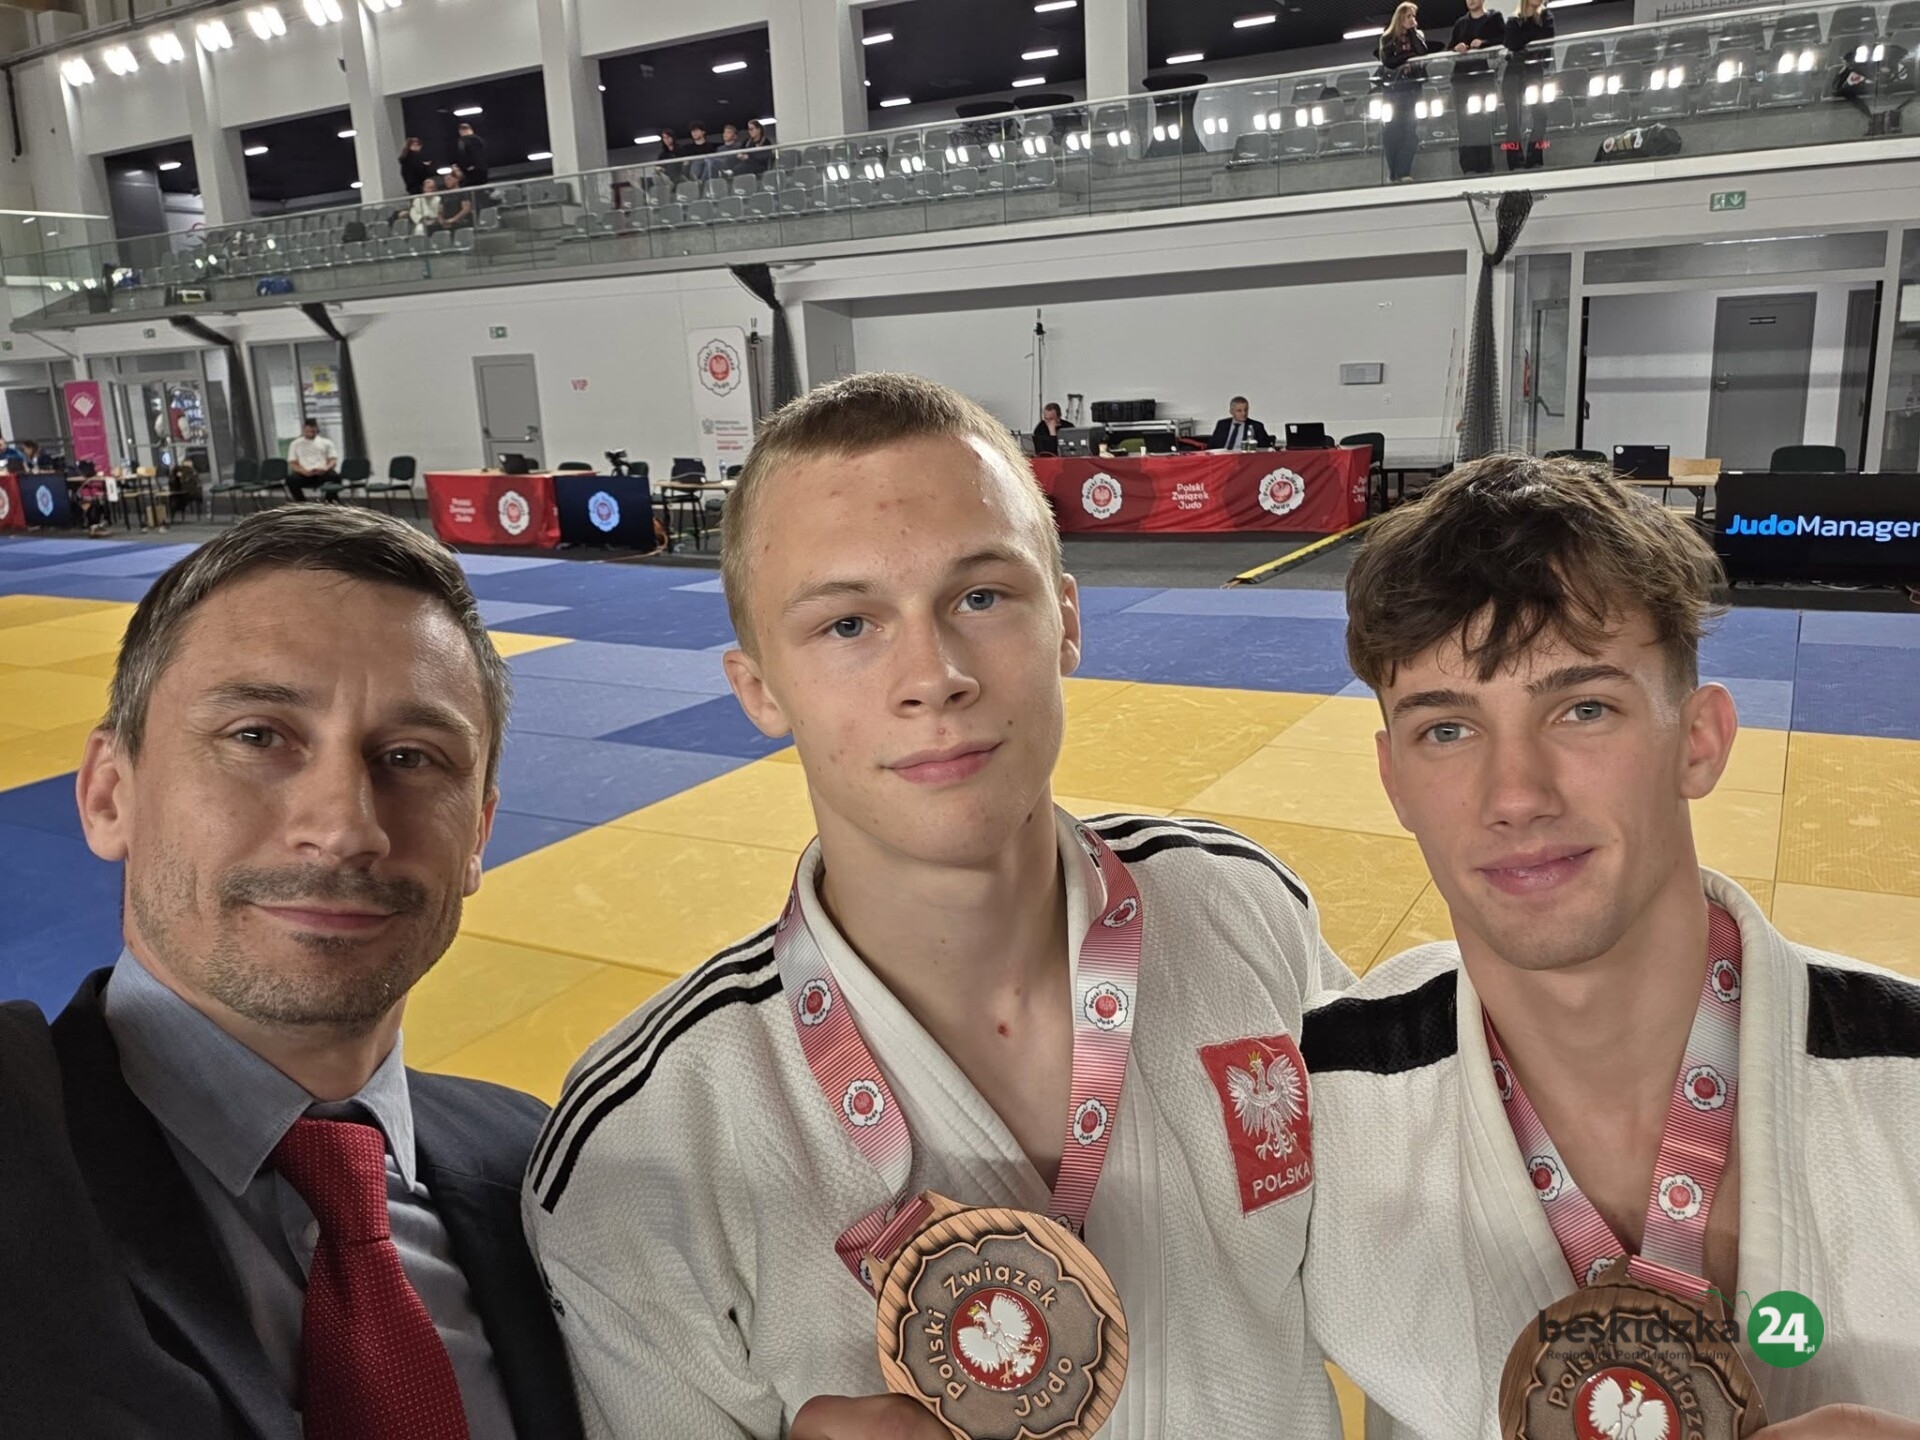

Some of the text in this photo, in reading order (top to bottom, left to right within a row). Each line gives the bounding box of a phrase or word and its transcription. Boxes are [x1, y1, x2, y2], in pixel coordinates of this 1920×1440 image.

[571, 379, 588, 391] VIP
[1171, 491, 1209, 501] Związek
[1176, 483, 1205, 492] Polski
[1178, 501, 1202, 510] Judo
[1725, 514, 1920, 542] JudoManager
[1252, 1161, 1311, 1199] POLSKA
[924, 1261, 1058, 1401] Polski Związek
[1014, 1356, 1074, 1417] Judo
[1636, 1342, 1704, 1440] Związe
